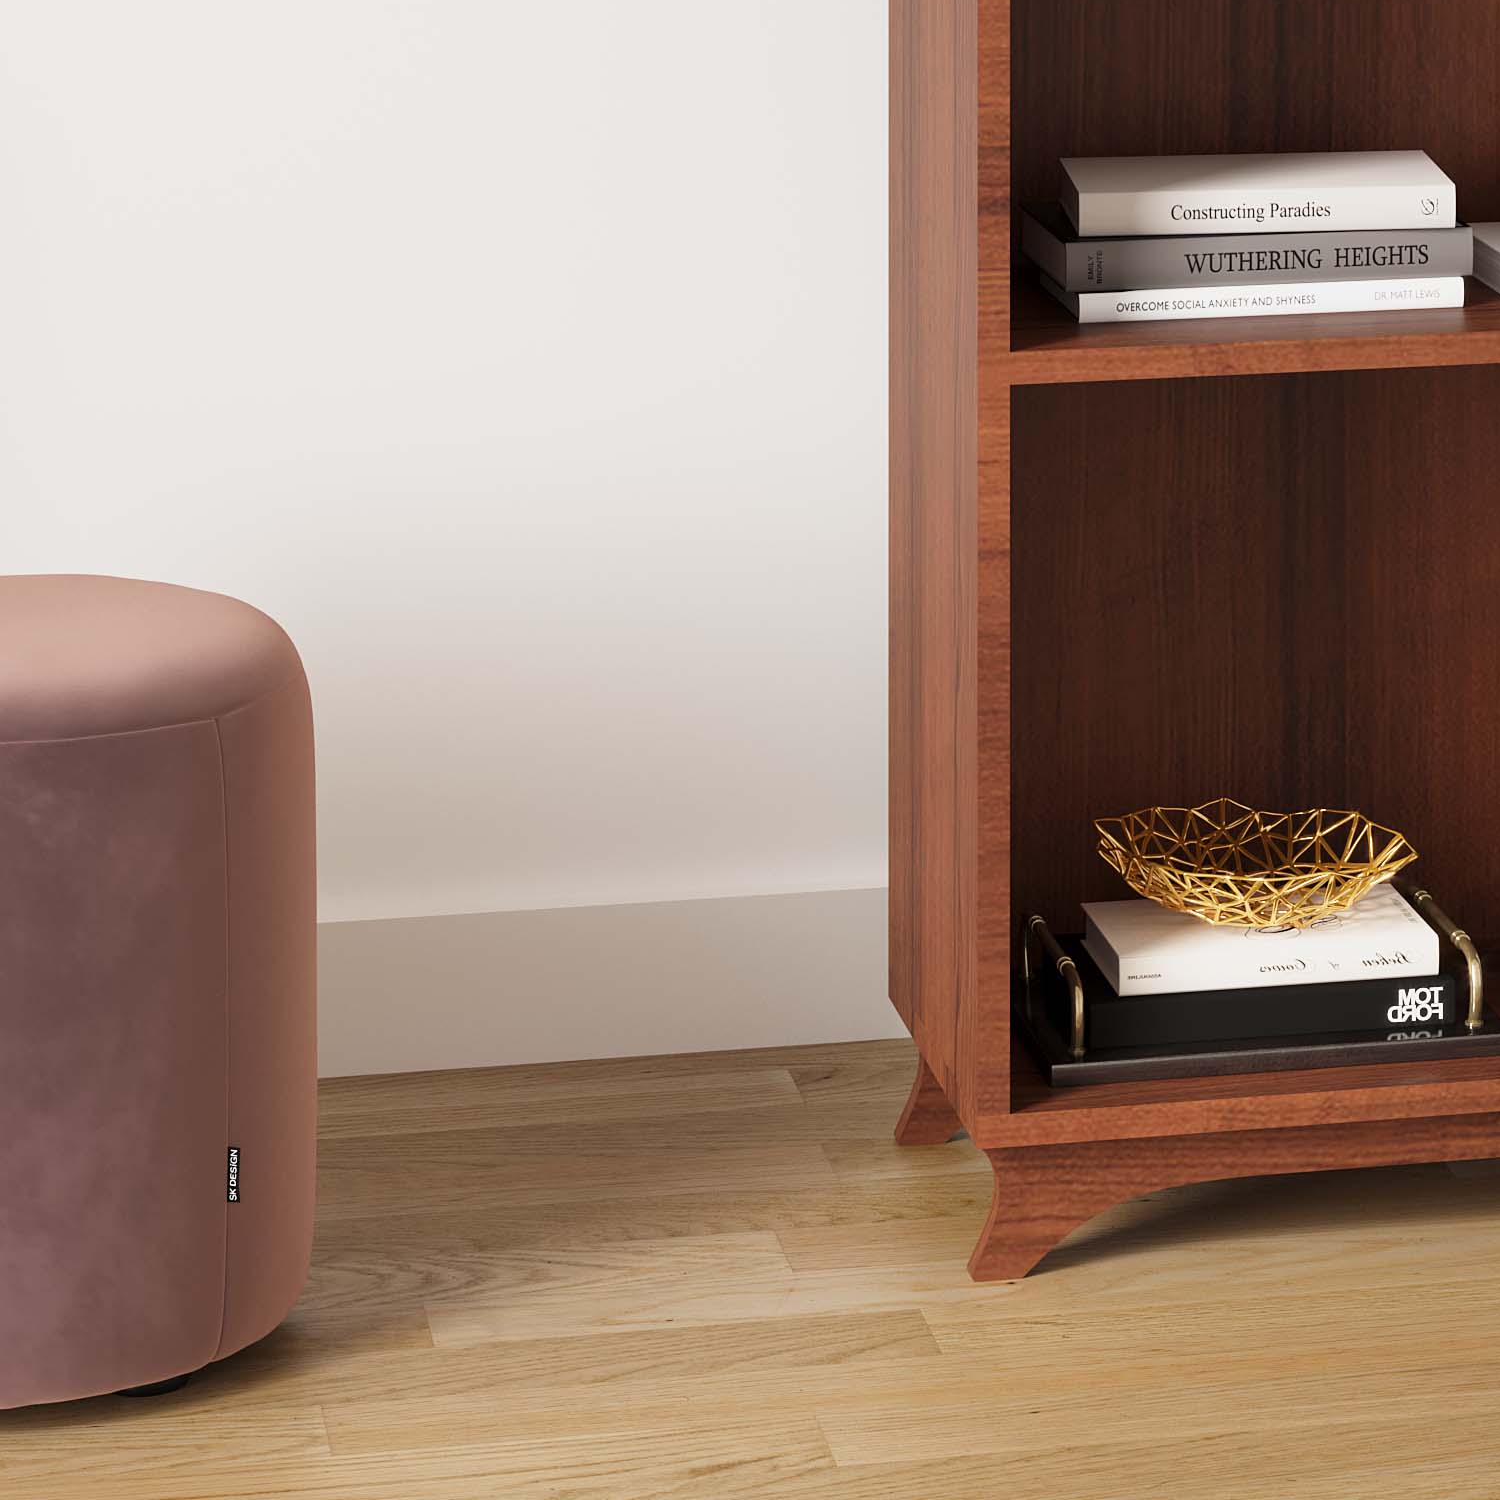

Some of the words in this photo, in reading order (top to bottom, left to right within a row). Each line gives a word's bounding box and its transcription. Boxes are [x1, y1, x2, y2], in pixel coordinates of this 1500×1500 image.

[1171, 202, 1265, 222] Constructing
[1269, 201, 1331, 219] Paradies
[1184, 248, 1323, 275] WUTHERING
[1334, 244, 1429, 268] HEIGHTS
[1116, 300, 1170, 313] OVERCOME
[1172, 299, 1206, 311] SOCIAL
[1208, 297, 1249, 309] ANXIETY
[1252, 296, 1272, 307] AND
[1276, 294, 1316, 306] SHYNESS
[229, 1149, 238, 1187] DESIGN
[229, 1188, 238, 1201] SK
